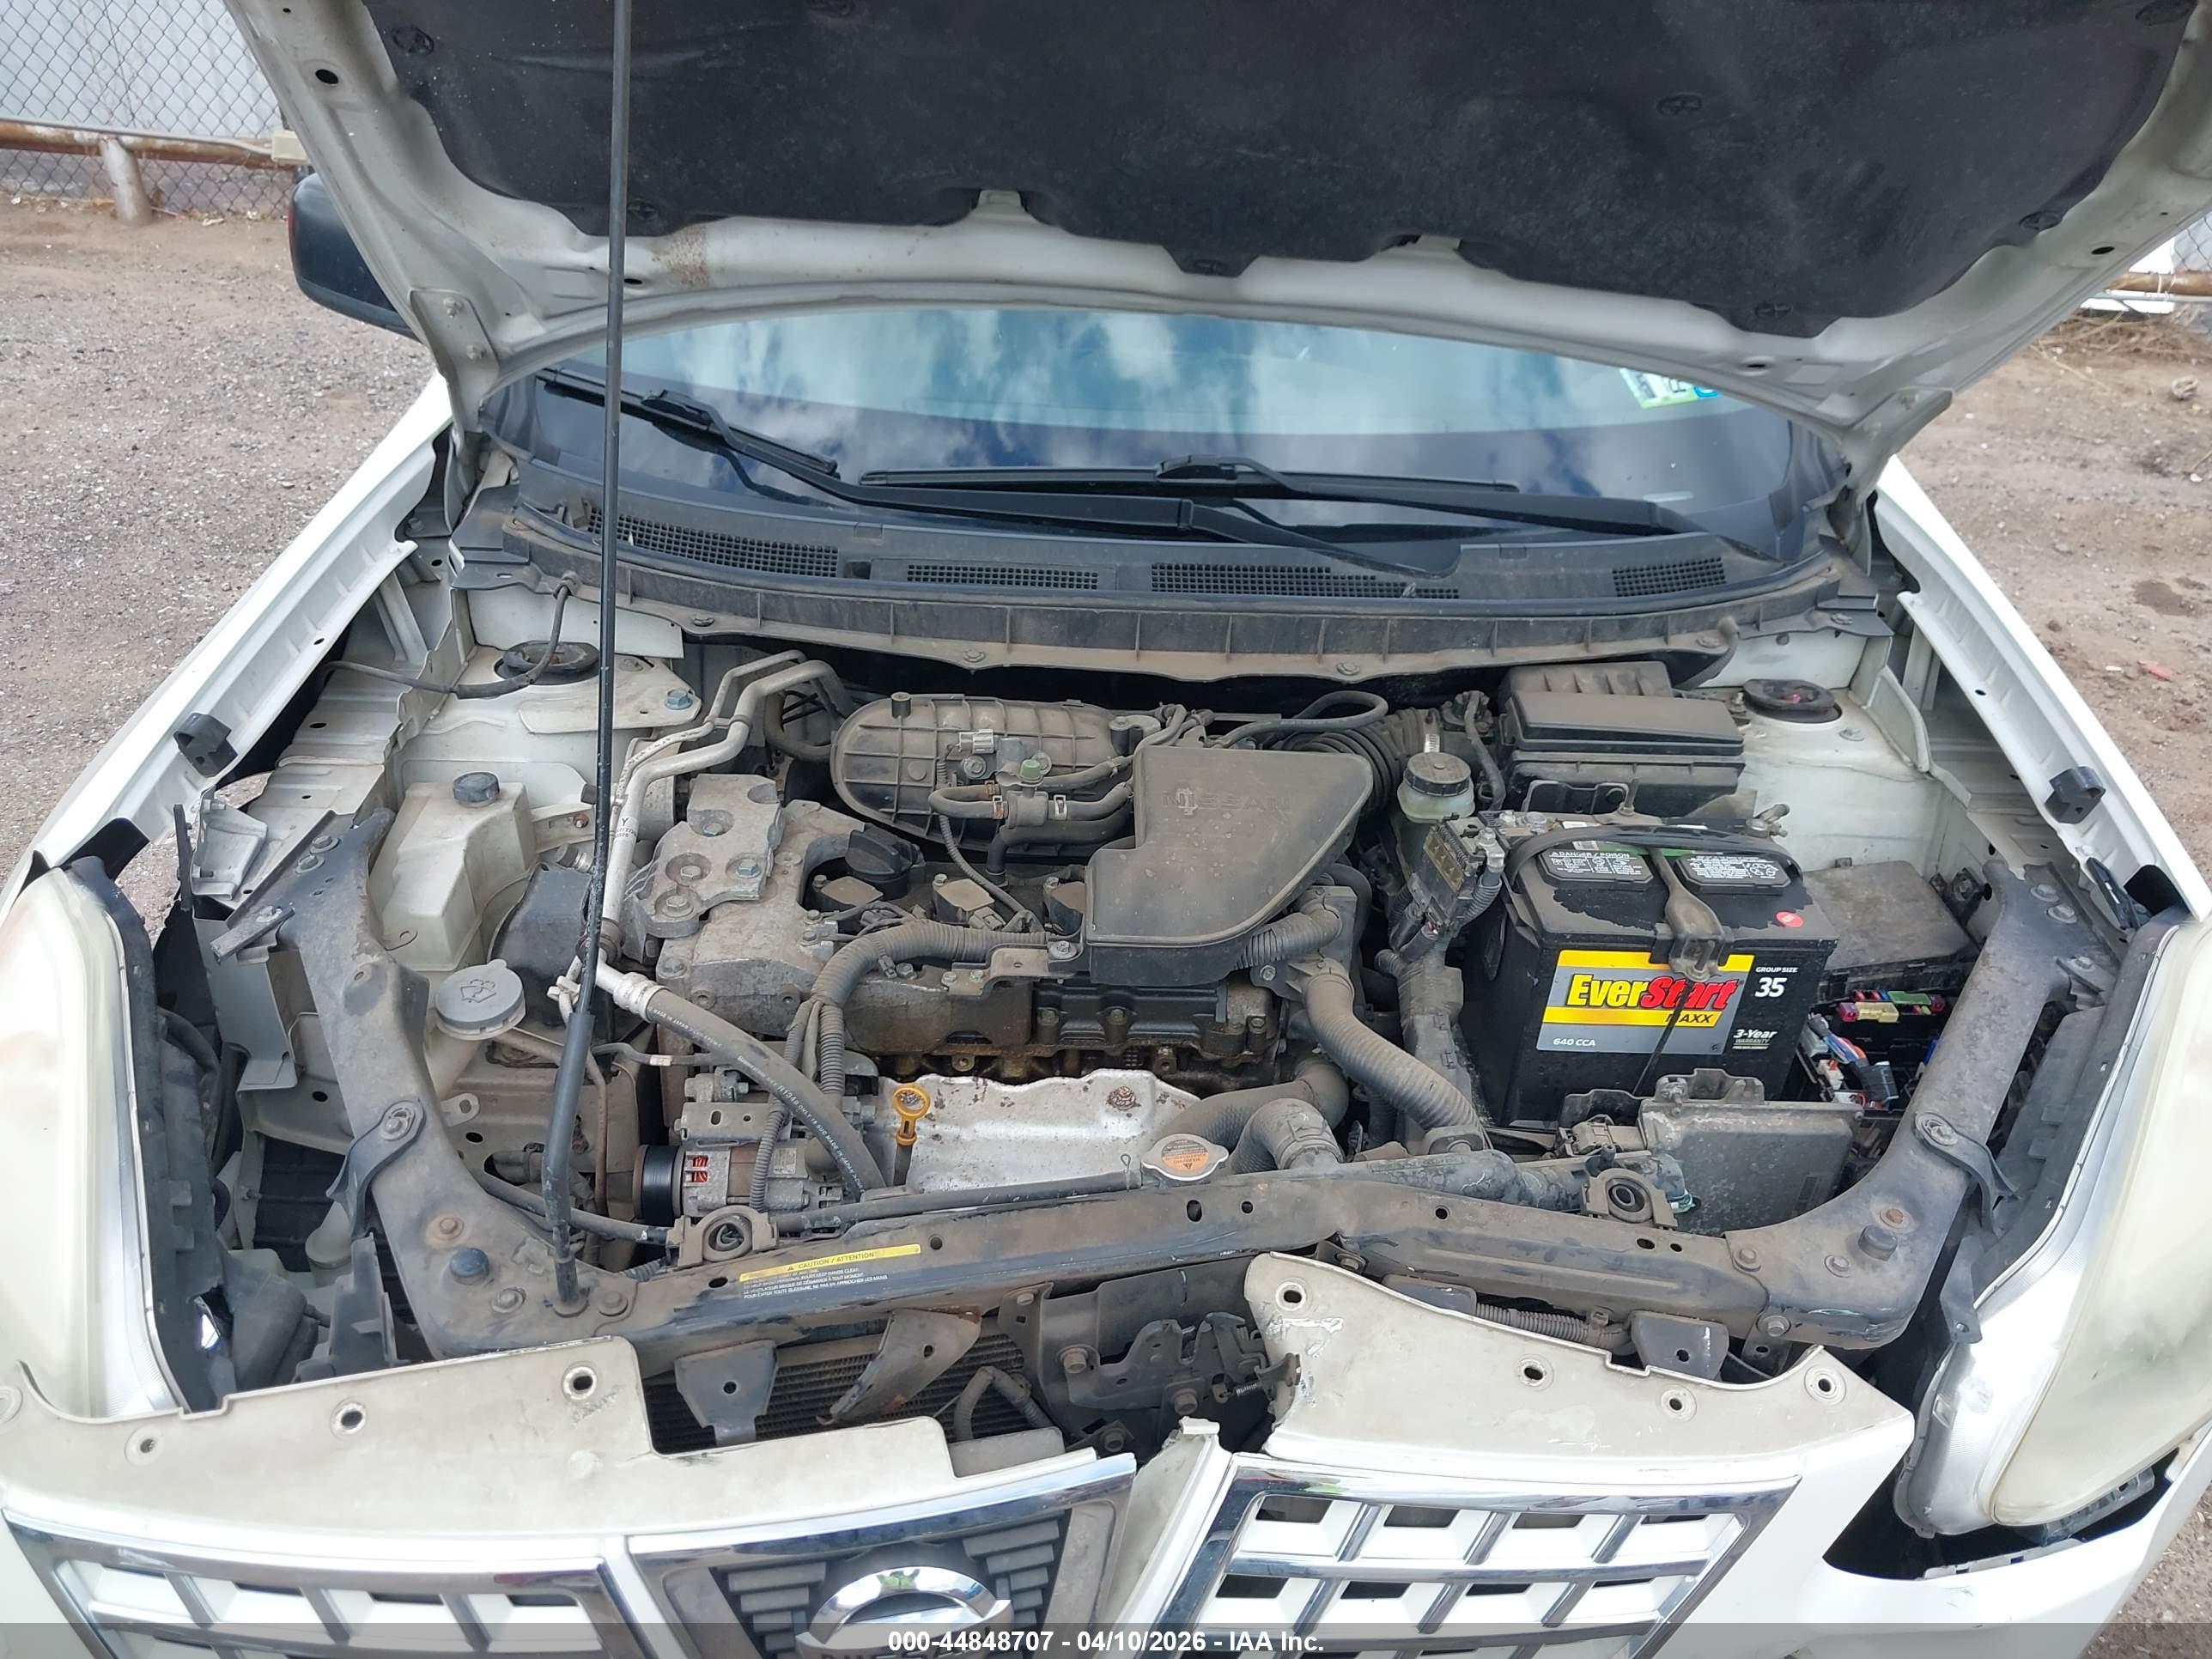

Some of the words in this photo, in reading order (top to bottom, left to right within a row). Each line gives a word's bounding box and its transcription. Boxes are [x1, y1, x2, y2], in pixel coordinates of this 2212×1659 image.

[1566, 974, 1740, 1010] EverStart
[1754, 977, 1788, 998] 35
[1553, 1037, 1574, 1047] 640
[1575, 1038, 1596, 1048] CCA
[1733, 1029, 1778, 1039] 3-Year
[798, 1259, 830, 1270] CAUTION
[836, 1251, 875, 1263] ATTENTION
